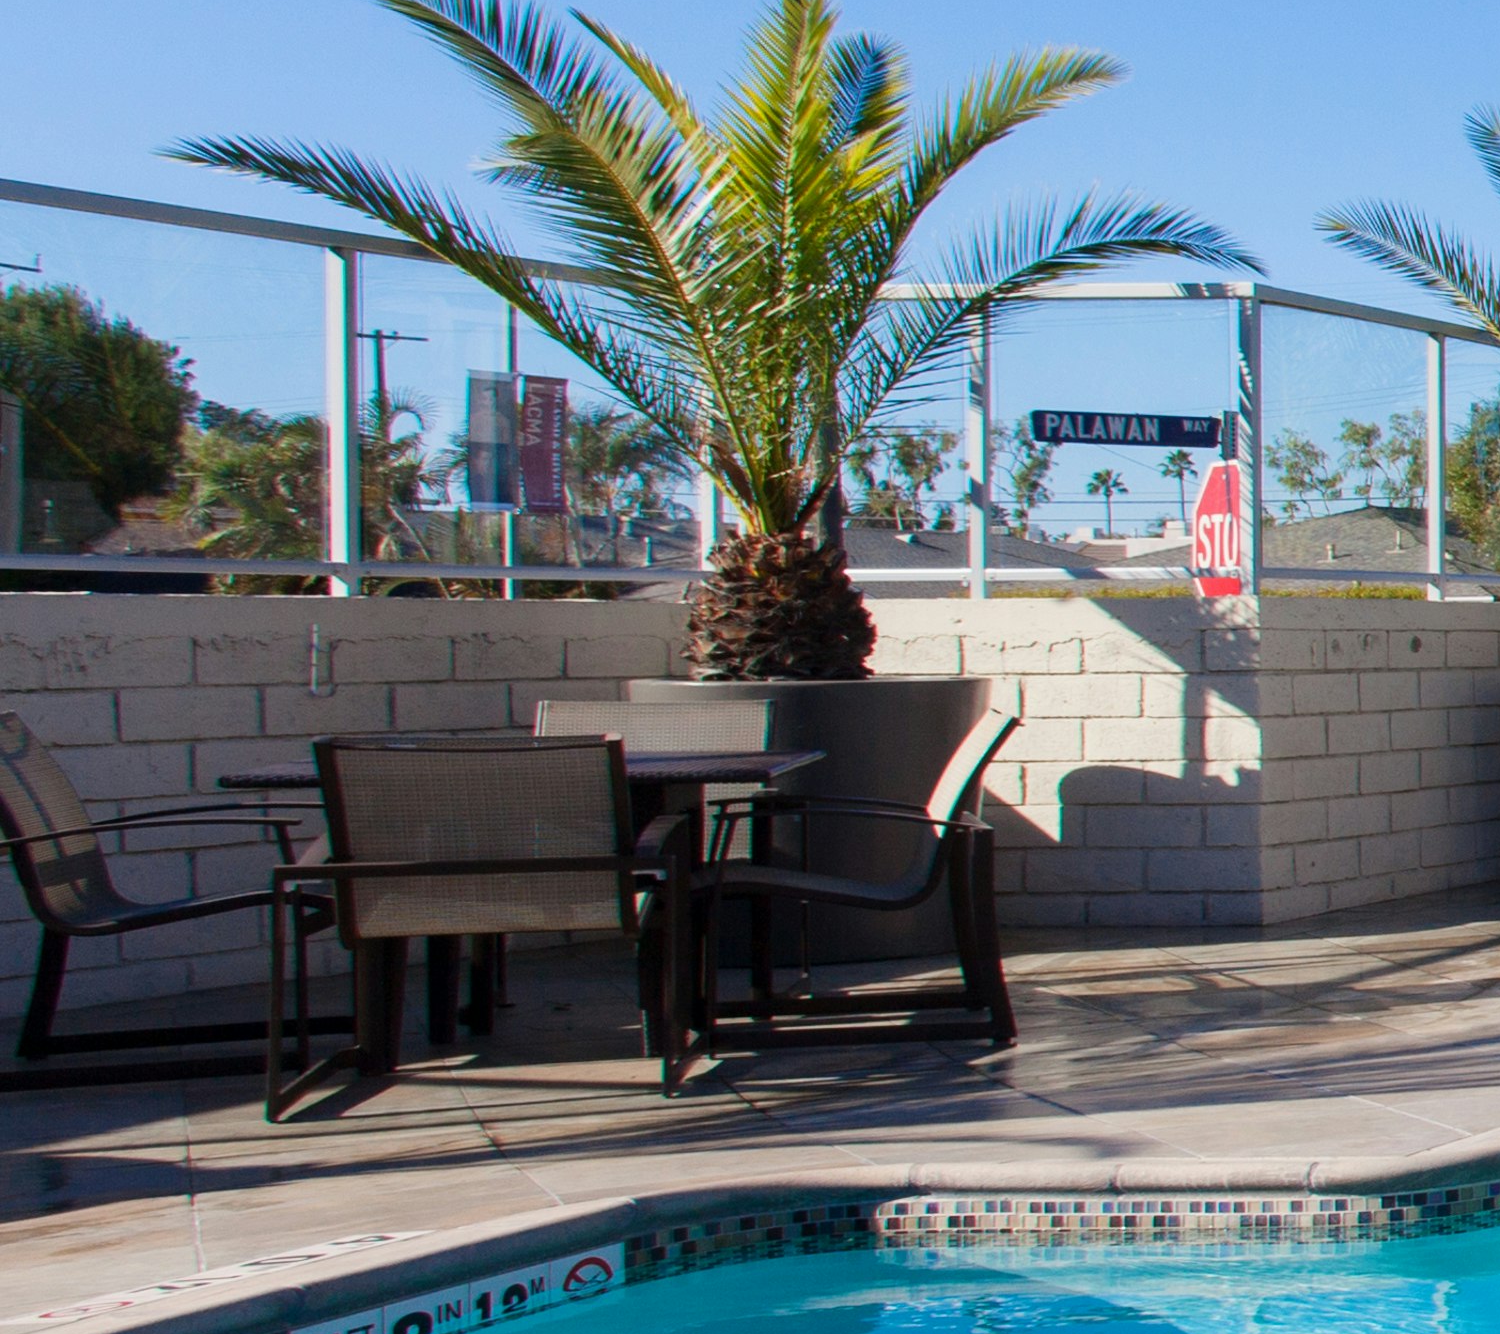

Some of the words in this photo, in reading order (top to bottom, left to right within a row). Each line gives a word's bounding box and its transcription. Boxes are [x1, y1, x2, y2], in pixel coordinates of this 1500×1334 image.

[526, 383, 545, 446] LACMA
[1044, 414, 1160, 442] PALAWAN
[1182, 419, 1211, 433] WAY
[1197, 512, 1239, 569] STO
[437, 1299, 464, 1324] IN
[530, 1275, 546, 1296] M
